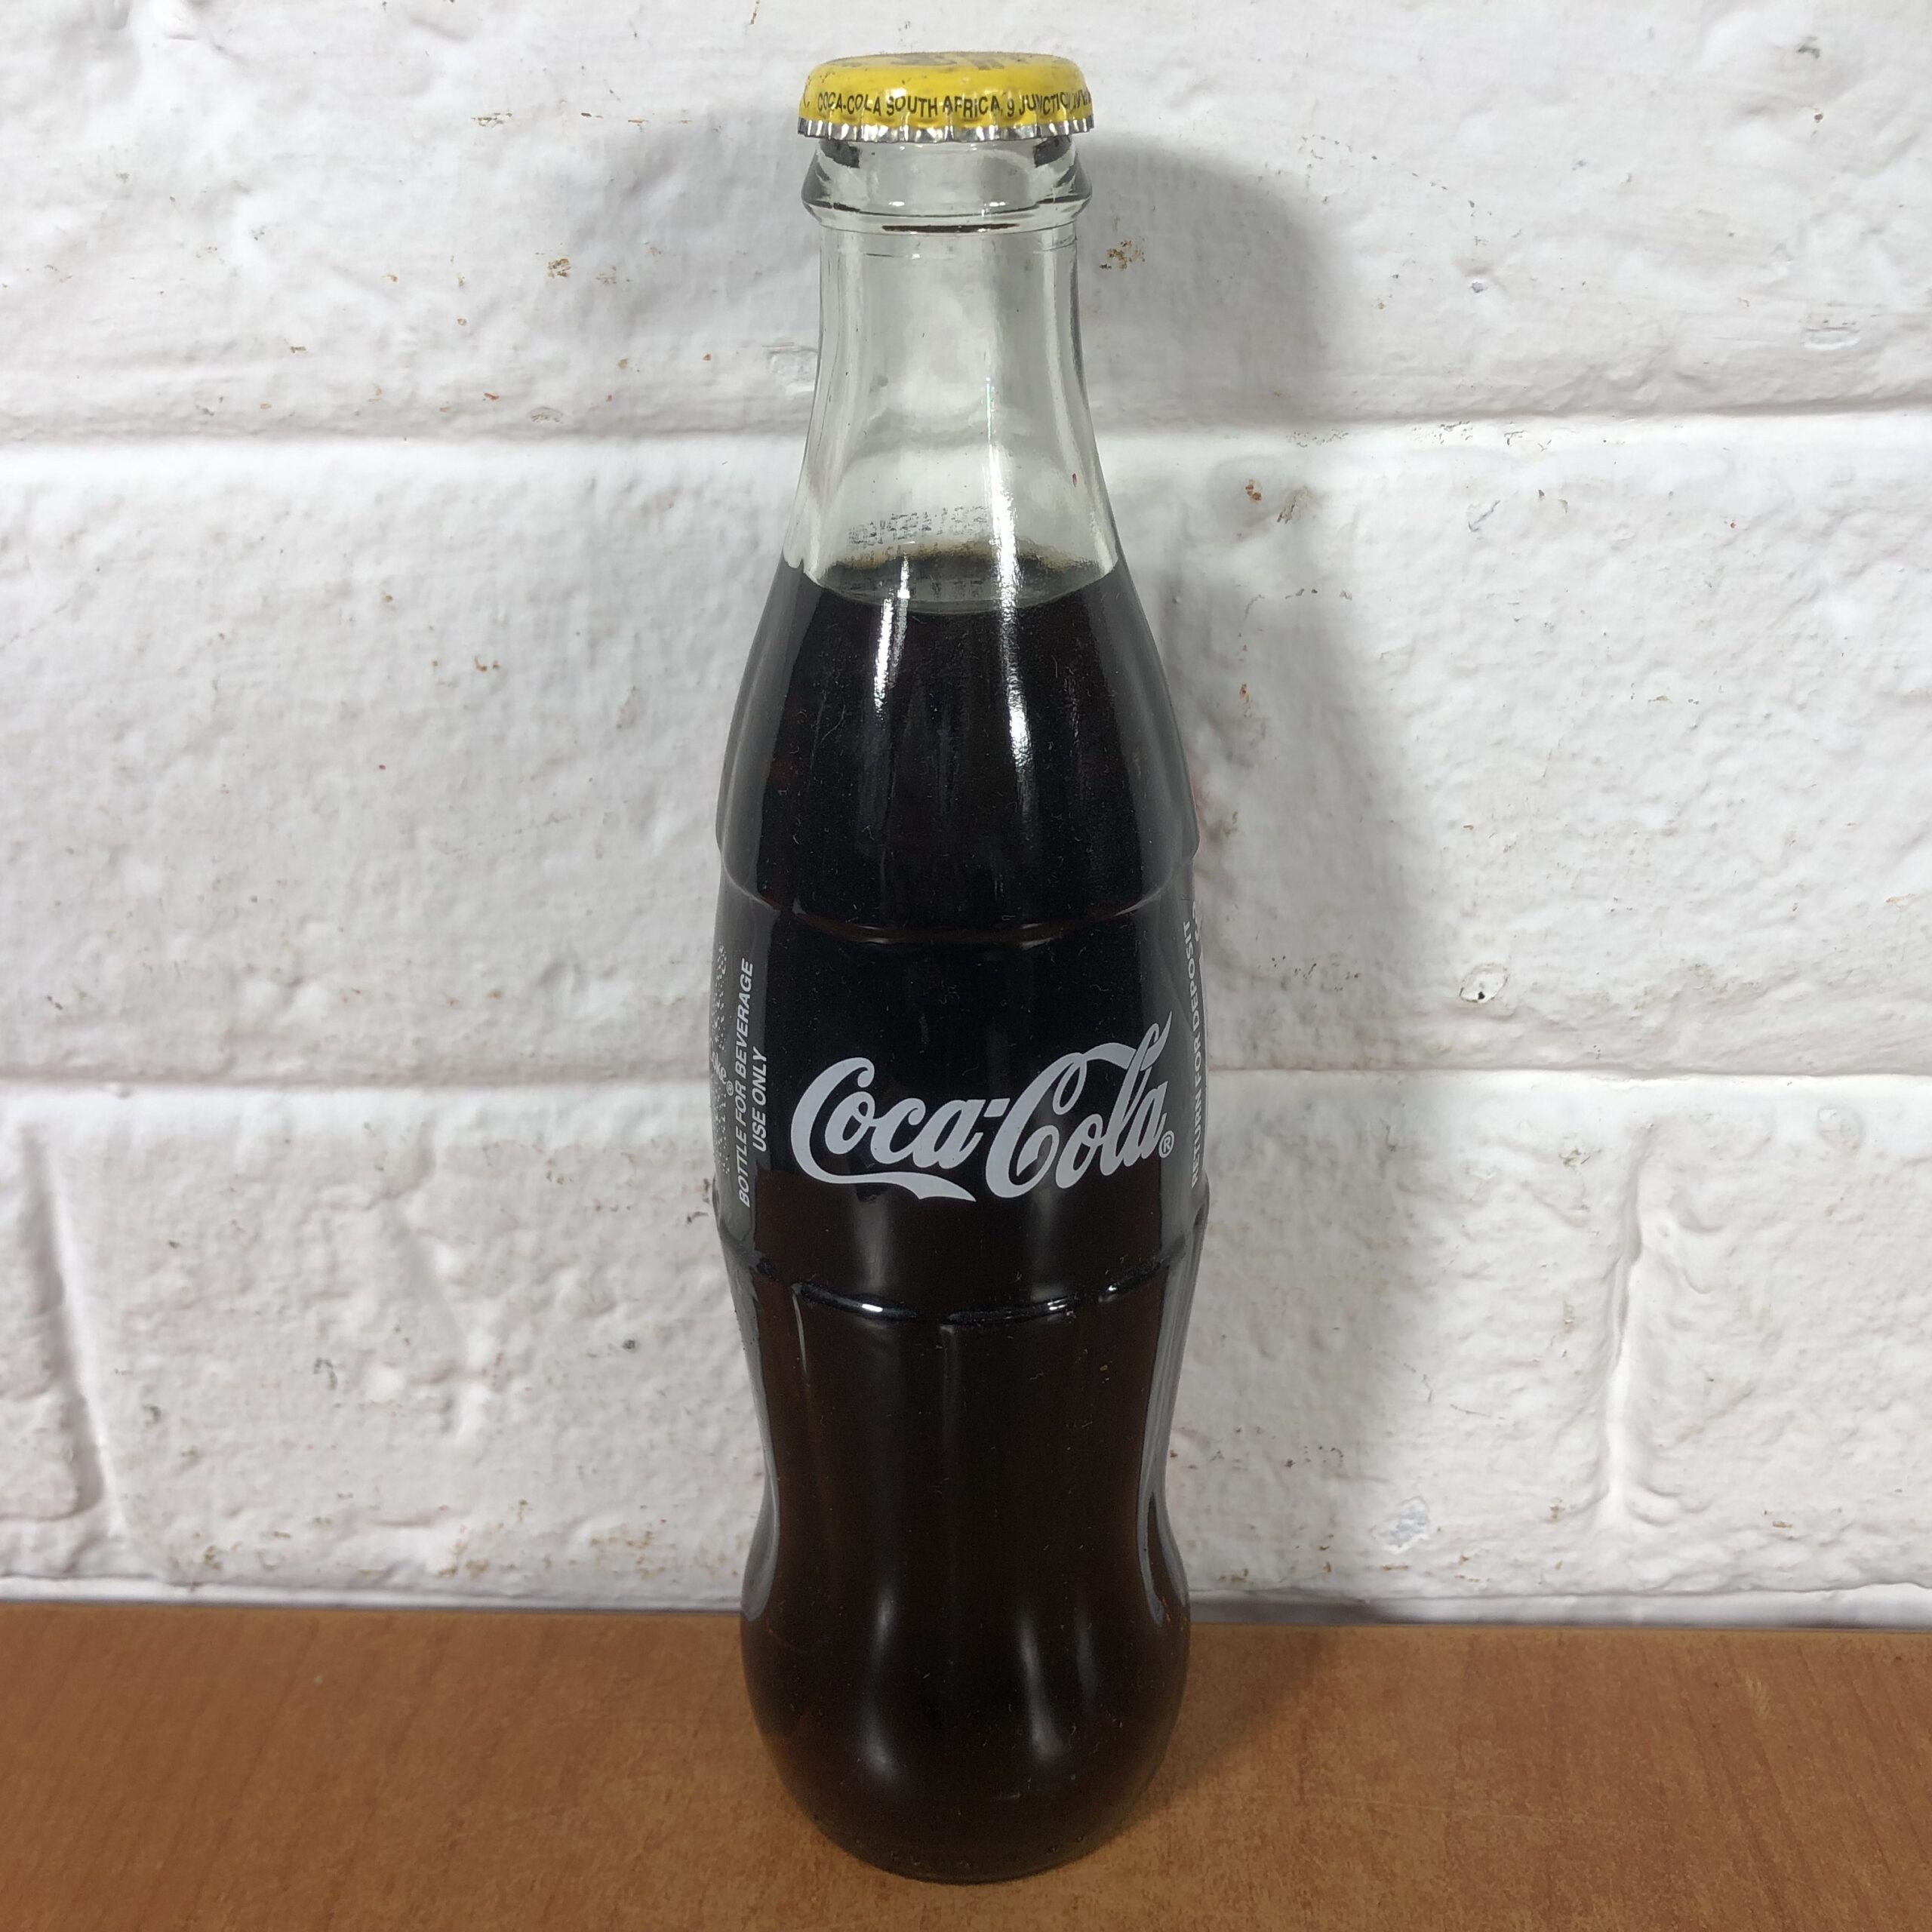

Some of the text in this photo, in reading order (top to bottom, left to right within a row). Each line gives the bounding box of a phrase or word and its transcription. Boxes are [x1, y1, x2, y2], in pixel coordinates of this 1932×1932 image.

[886, 95, 937, 118] SOUTH
[1007, 97, 1015, 117] 9
[1183, 921, 1200, 1032] DEPOSIT
[735, 958, 753, 1208] BOTTLE FOR BEVERAGE
[752, 1046, 768, 1152] USE ONLY
[1192, 1088, 1202, 1189] RETURN
